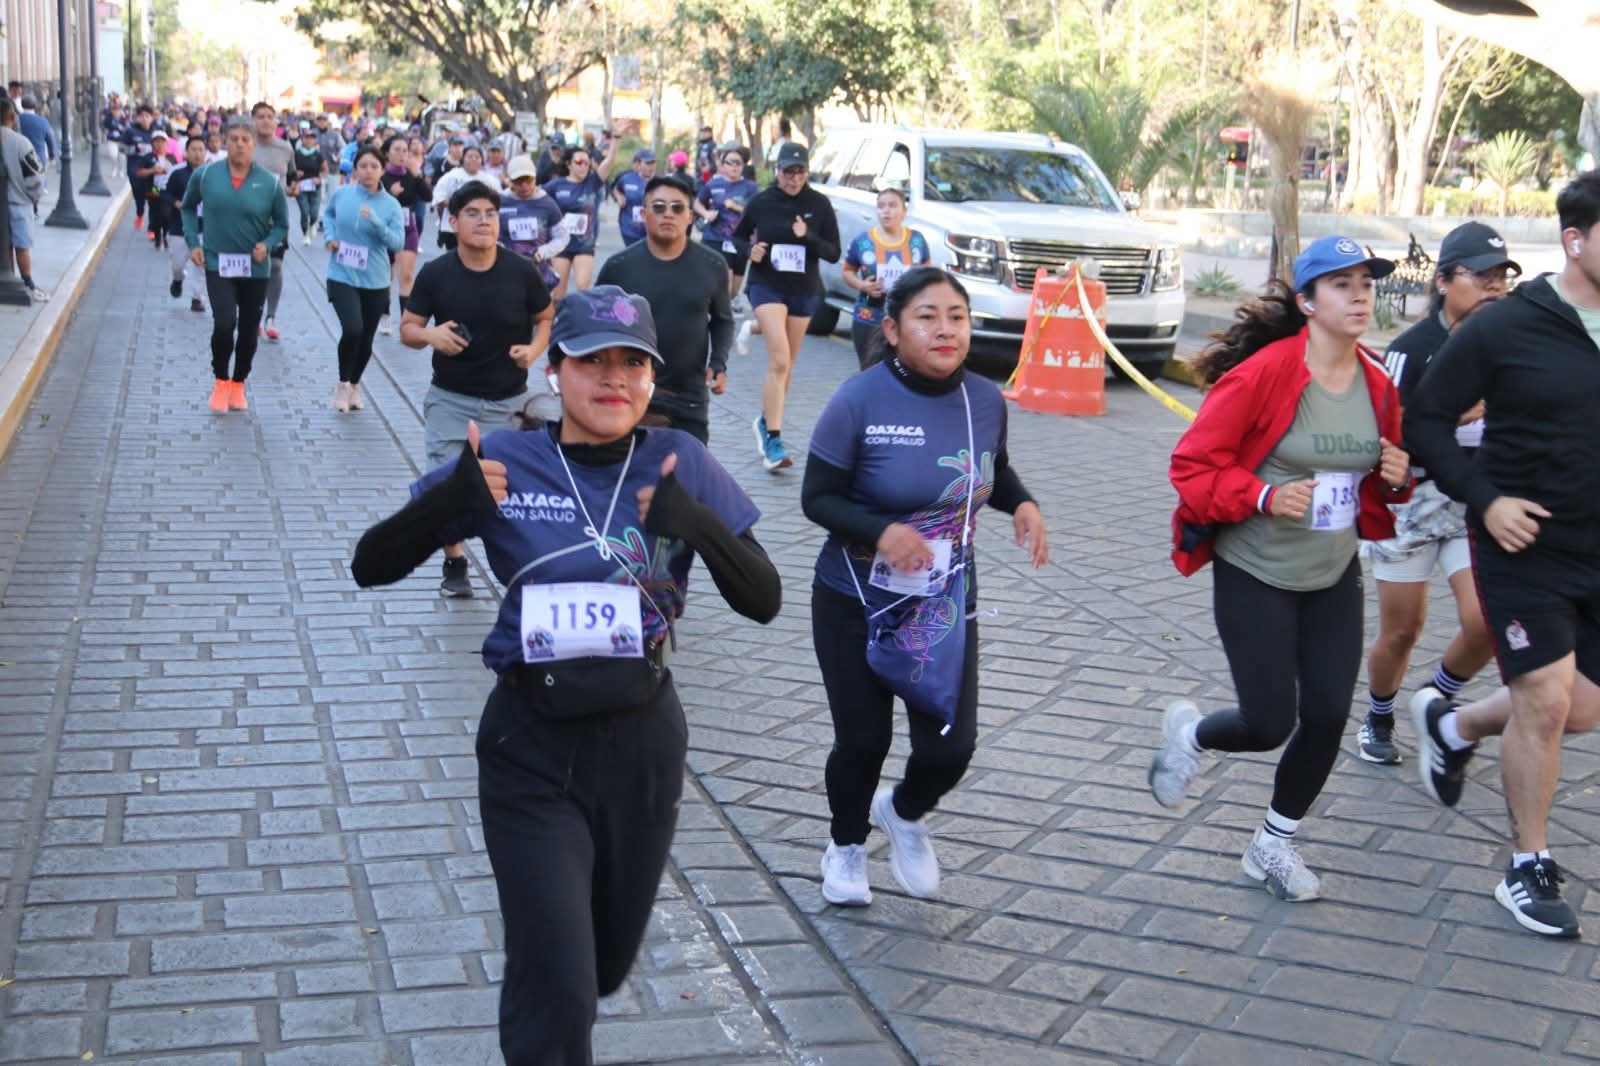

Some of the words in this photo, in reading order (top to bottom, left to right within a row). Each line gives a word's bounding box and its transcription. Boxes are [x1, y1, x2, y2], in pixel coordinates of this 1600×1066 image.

[864, 424, 925, 436] OAXACA
[865, 436, 889, 445] CON
[891, 436, 926, 446] SALUD
[1312, 432, 1379, 455] Wilso
[529, 509, 576, 524] SALUD
[549, 602, 617, 630] 1159
